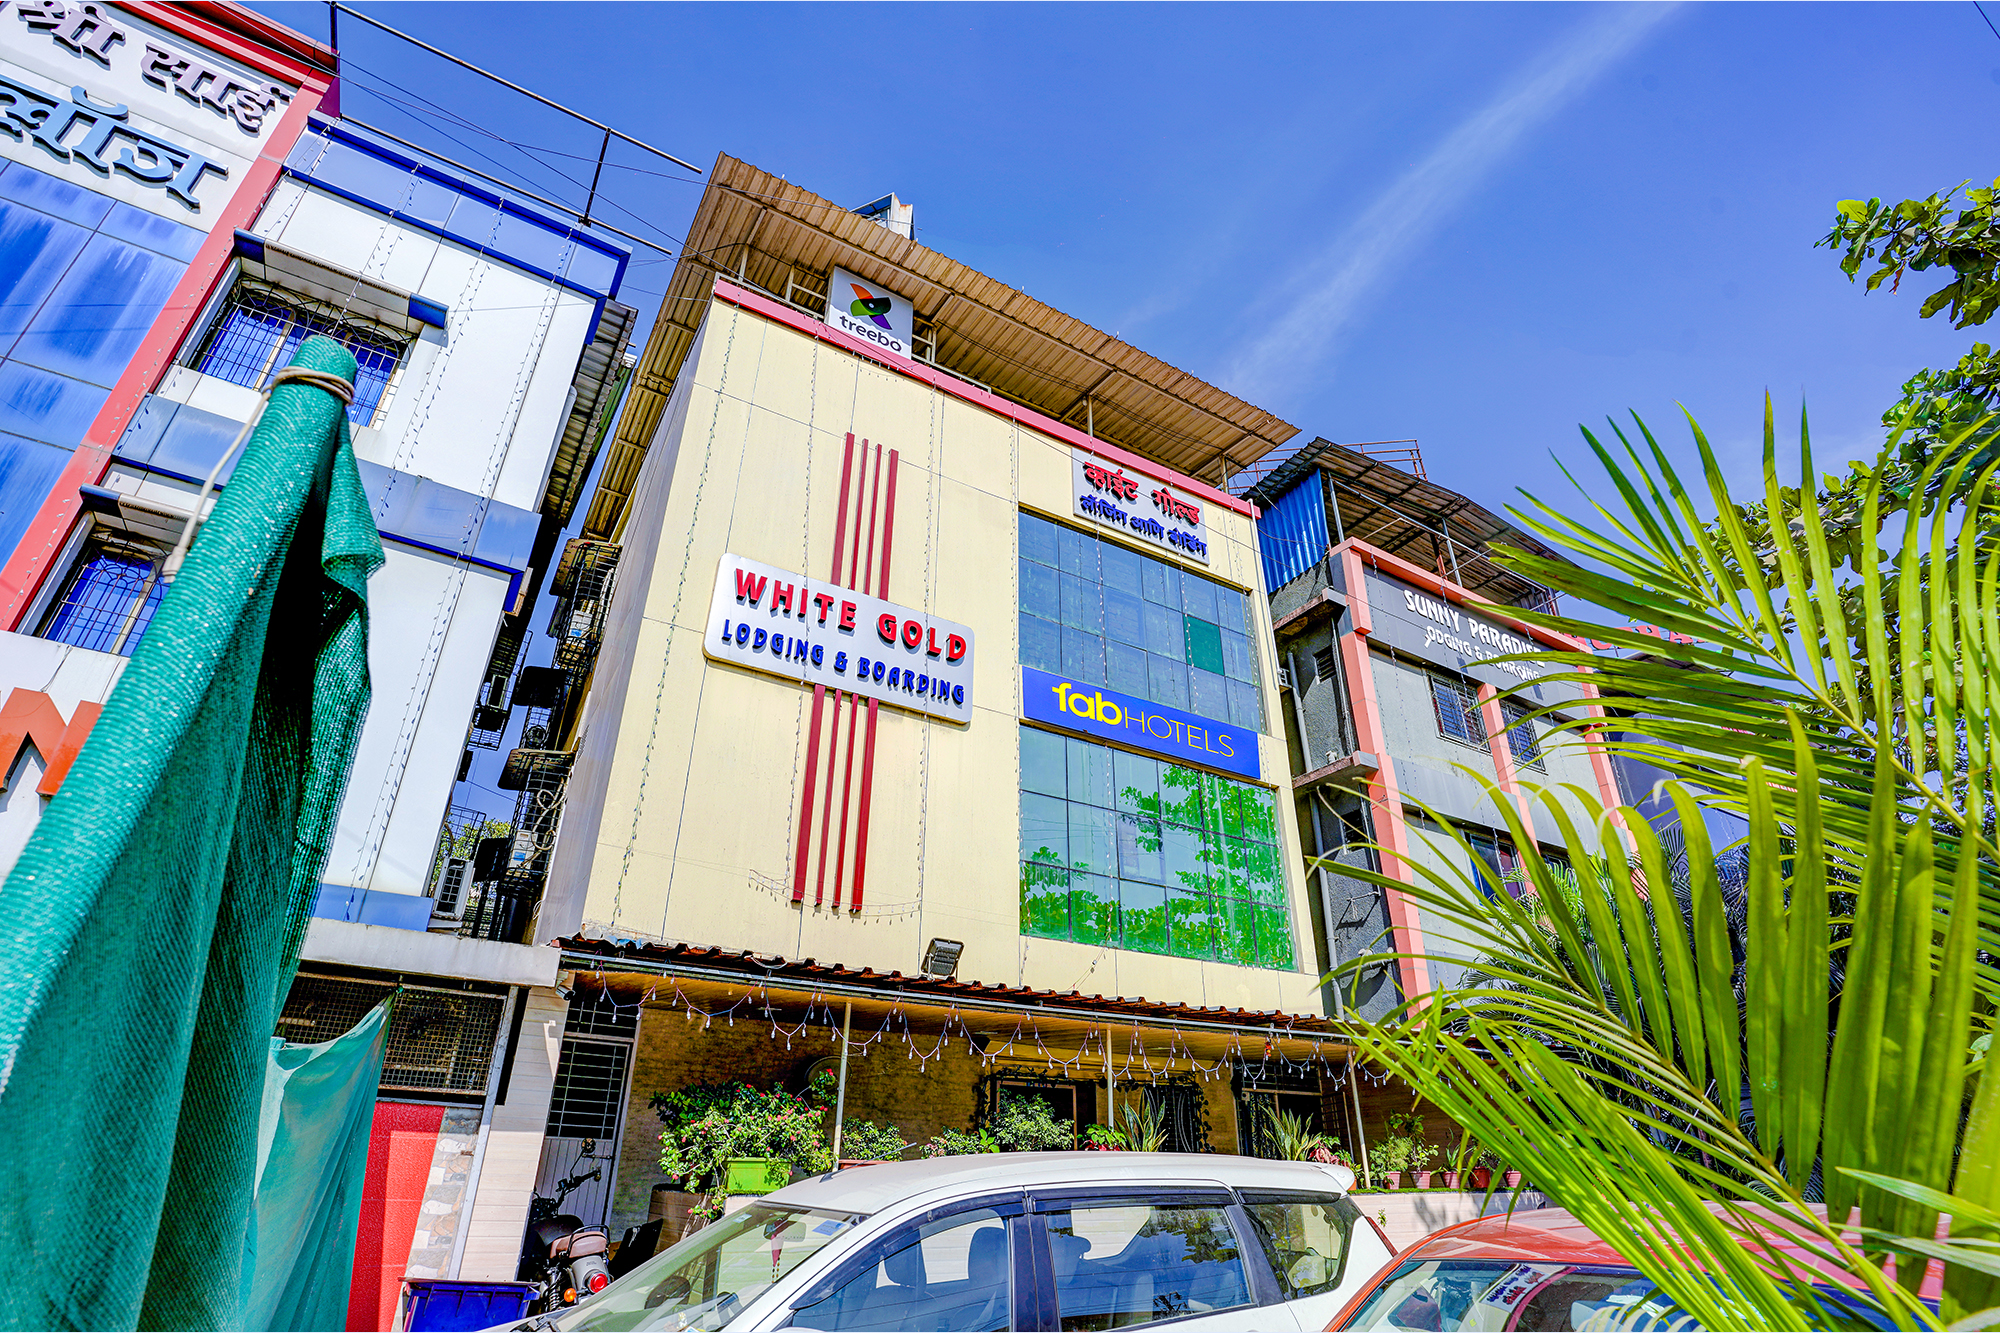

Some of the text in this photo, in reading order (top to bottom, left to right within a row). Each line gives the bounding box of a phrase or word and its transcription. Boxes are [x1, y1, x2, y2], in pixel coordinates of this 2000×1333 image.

[141, 42, 290, 132] साई
[838, 315, 902, 352] treebo
[1130, 516, 1165, 539] आणि
[1152, 487, 1200, 524] गोल्ड
[734, 568, 967, 662] WHITE GOLD
[1403, 589, 1460, 633] SUNNY
[1467, 617, 1545, 668] PARADISE
[721, 619, 965, 704] LODGING & BOARDING
[1474, 645, 1484, 662] &
